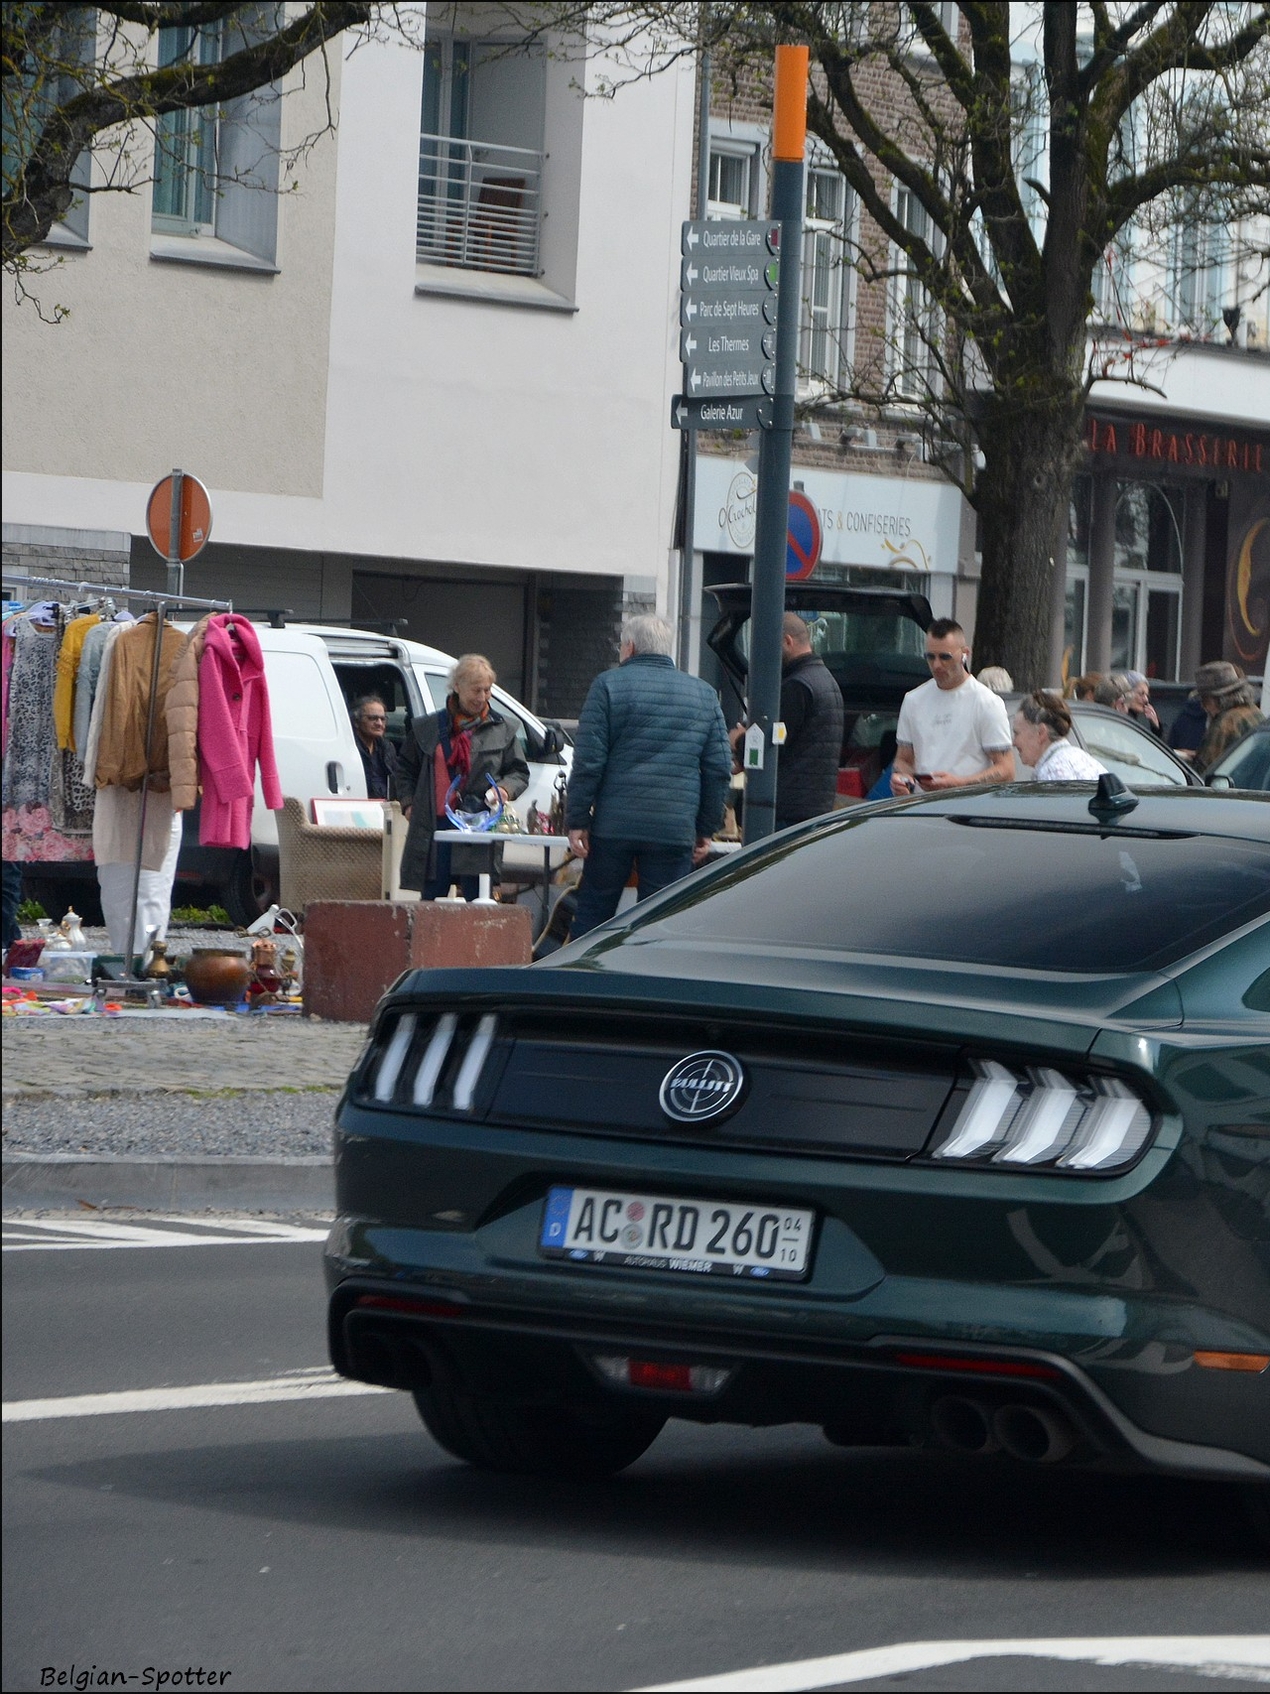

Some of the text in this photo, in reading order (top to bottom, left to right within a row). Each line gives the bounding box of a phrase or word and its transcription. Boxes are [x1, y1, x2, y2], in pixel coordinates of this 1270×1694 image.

[703, 230, 761, 248] Quartier de la Gare
[703, 264, 759, 284] Quartier Vieux Spa
[700, 300, 759, 320] Parc de Sept Heures
[708, 335, 749, 352] Les Thermes
[702, 371, 722, 387] Pavillon
[723, 370, 732, 386] des
[732, 370, 747, 386] Petits
[700, 404, 743, 420] Galerie Azur
[1090, 419, 1117, 454] LA
[1133, 422, 1263, 474] BRASSERIE
[846, 511, 911, 537] CONFISERIES
[549, 1222, 561, 1237] D
[573, 1197, 779, 1259] AC RD 260
[783, 1217, 802, 1231] 04
[780, 1248, 797, 1262] 10
